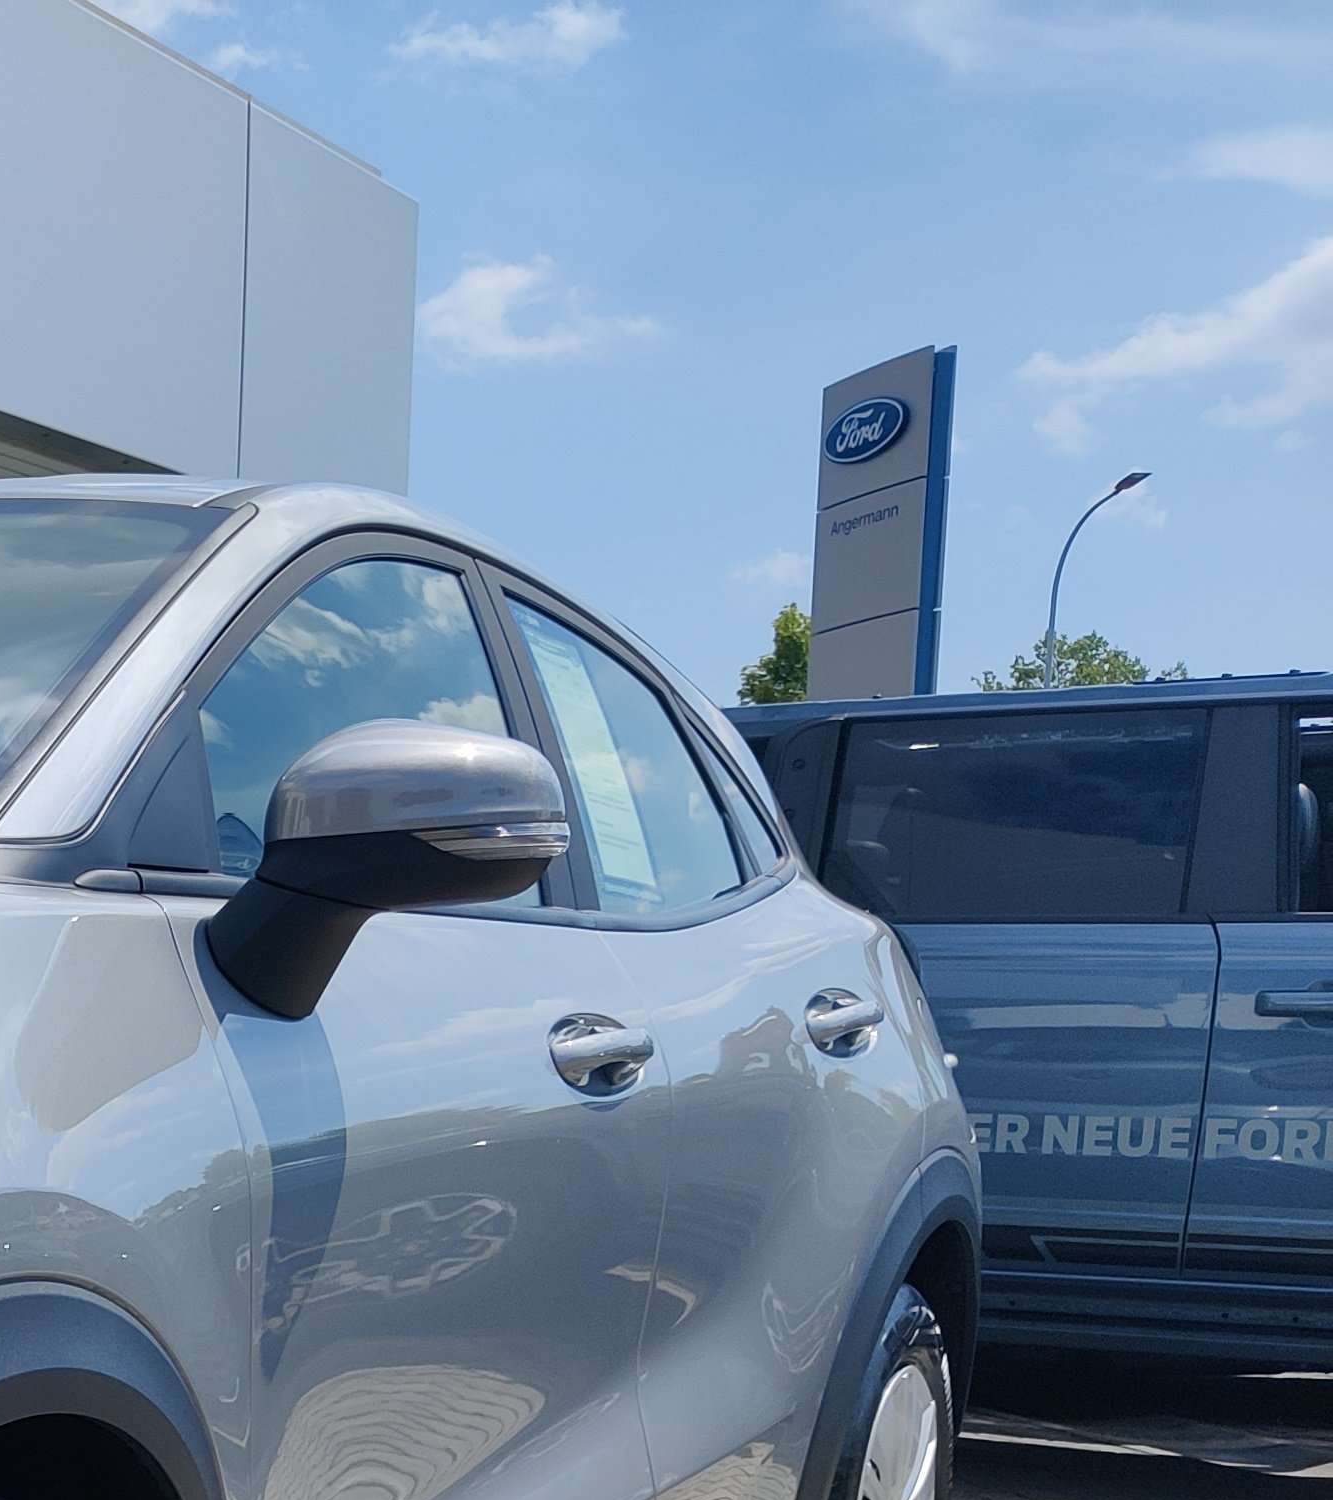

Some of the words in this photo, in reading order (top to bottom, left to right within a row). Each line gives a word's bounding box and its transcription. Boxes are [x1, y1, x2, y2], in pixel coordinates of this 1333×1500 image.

[836, 408, 886, 453] Ford
[831, 505, 899, 536] Angermann
[1041, 1114, 1193, 1158] NEUE
[1203, 1118, 1333, 1168] FOR
